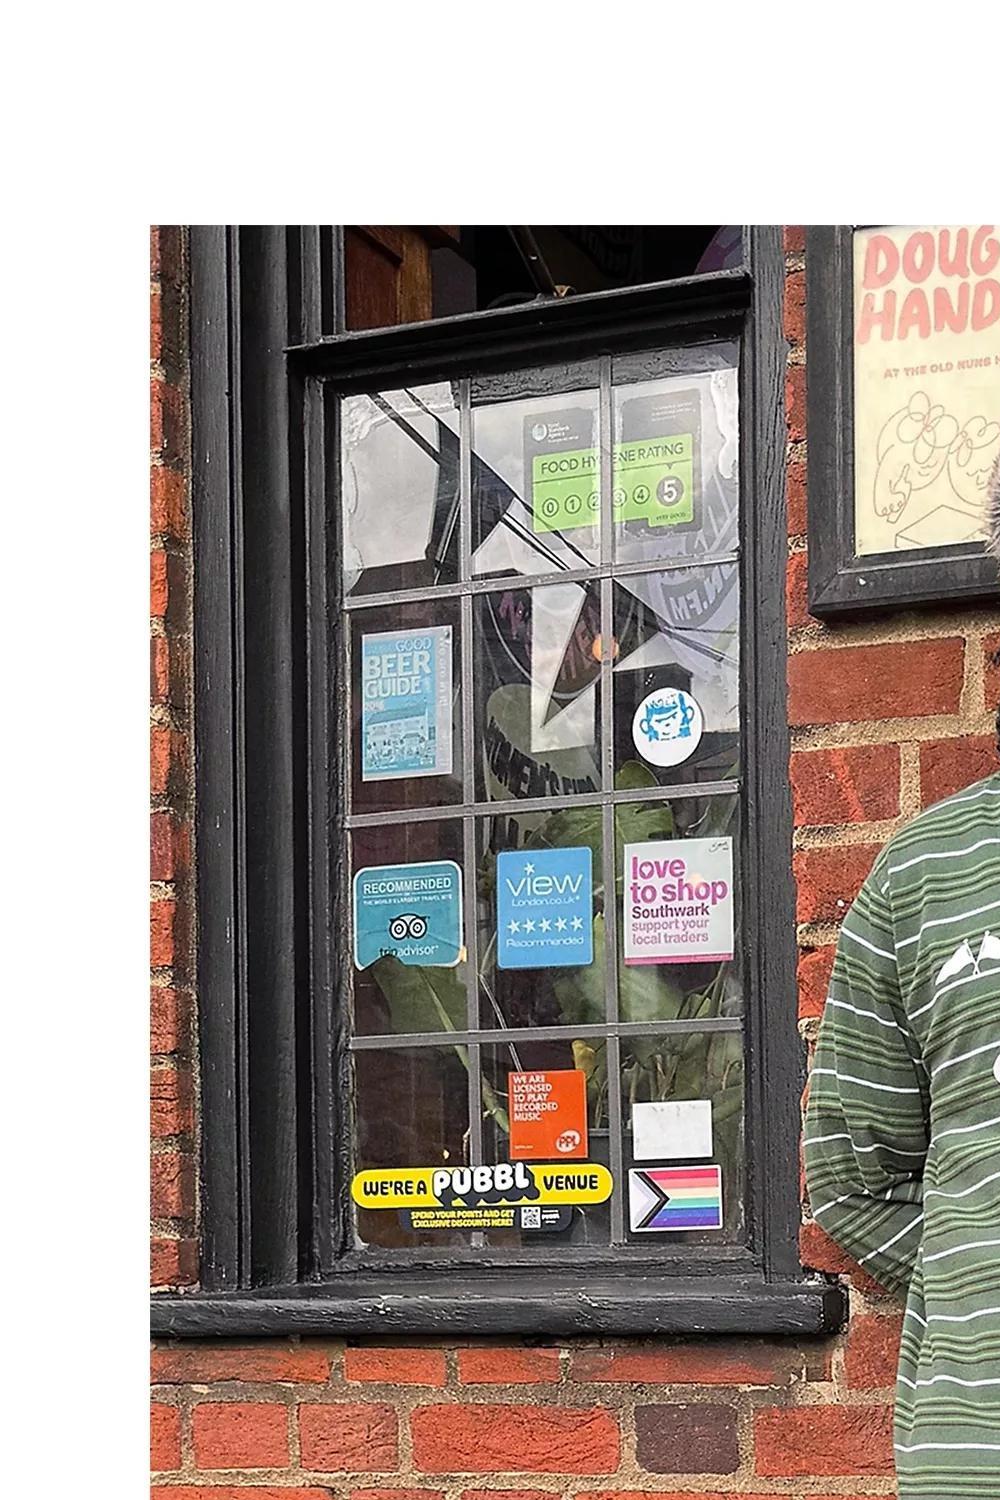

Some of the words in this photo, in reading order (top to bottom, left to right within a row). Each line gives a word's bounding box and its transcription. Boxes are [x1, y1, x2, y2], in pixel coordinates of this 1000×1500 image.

[883, 367, 900, 379] AT
[903, 365, 927, 377] THE
[930, 361, 954, 374] OLD
[540, 458, 580, 476] FOOD
[637, 441, 685, 462] RATING
[662, 478, 678, 503] 5
[364, 650, 432, 680] BEER
[364, 675, 422, 699] GUIDE
[632, 856, 686, 881] love
[362, 877, 452, 895] RECOMMENDED
[505, 864, 584, 897] view
[630, 882, 657, 904] to
[661, 877, 729, 906] shop
[631, 901, 710, 920] Southwark
[631, 919, 680, 934] support
[681, 918, 710, 931] your
[506, 936, 584, 949] Recommended
[632, 932, 661, 945] local
[663, 931, 709, 945] traders
[512, 1075, 527, 1084] WE
[528, 1074, 546, 1083] ARE
[513, 1083, 553, 1093] LICENSED
[513, 1093, 526, 1103] TO
[526, 1092, 549, 1102] PLAY
[514, 1101, 559, 1112] RECORDED
[363, 1180, 414, 1197] WE'RE
[416, 1179, 428, 1196] A
[432, 1161, 531, 1198] PUBBL
[542, 1174, 600, 1192] VENUE
[500, 1209, 516, 1218] GET
